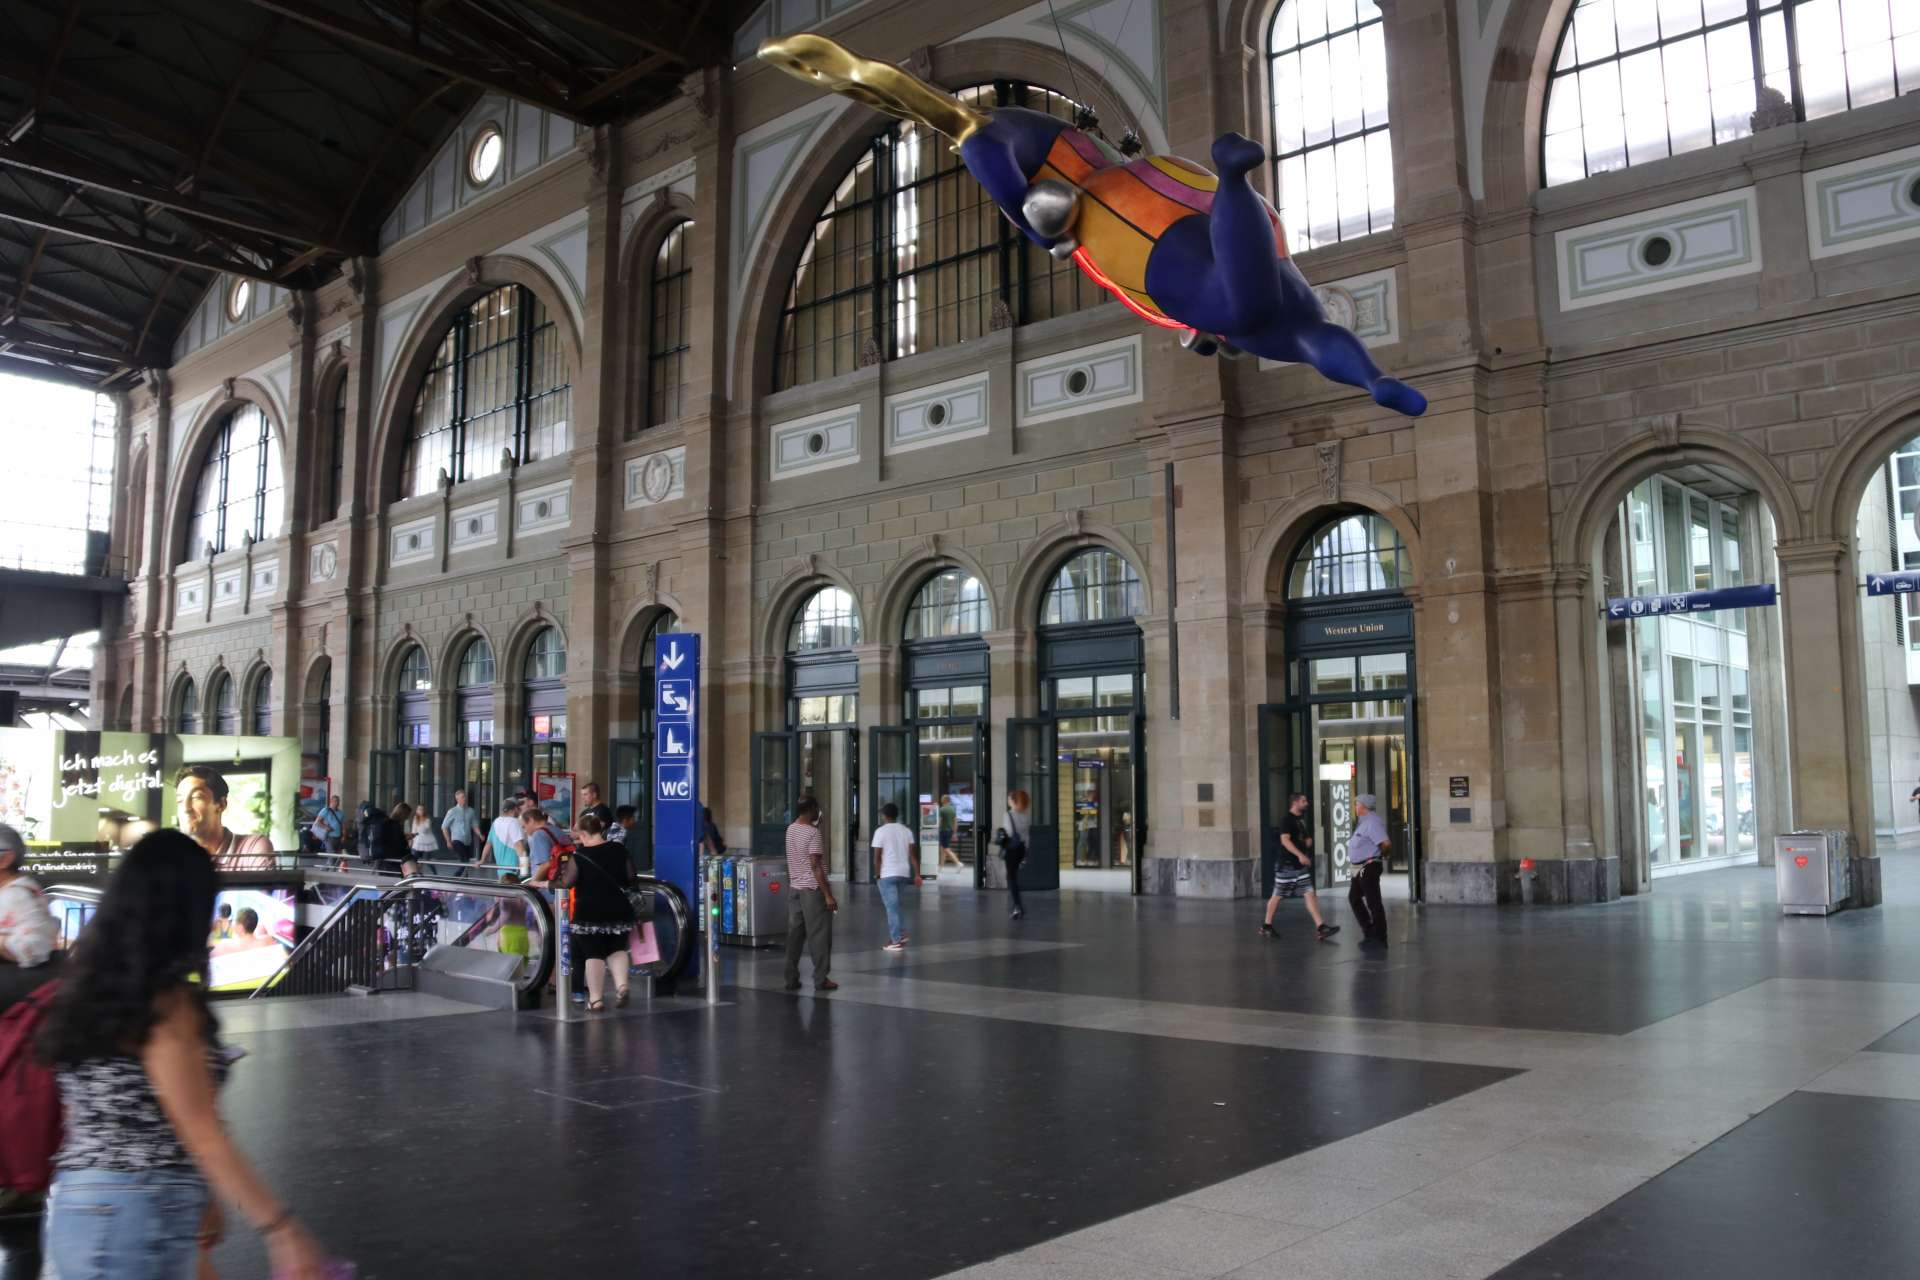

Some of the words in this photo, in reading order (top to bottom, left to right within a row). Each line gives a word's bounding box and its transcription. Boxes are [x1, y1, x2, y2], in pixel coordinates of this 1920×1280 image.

[1324, 626, 1358, 636] Western
[1360, 624, 1384, 632] Union
[59, 753, 87, 771] Ich
[91, 749, 134, 769] mach
[138, 749, 157, 764] es
[52, 778, 105, 808] jetzt
[108, 770, 164, 802] digital.
[661, 781, 689, 796] WC
[1333, 784, 1346, 882] FOTOS
[32, 862, 97, 874] Onlinebanking
